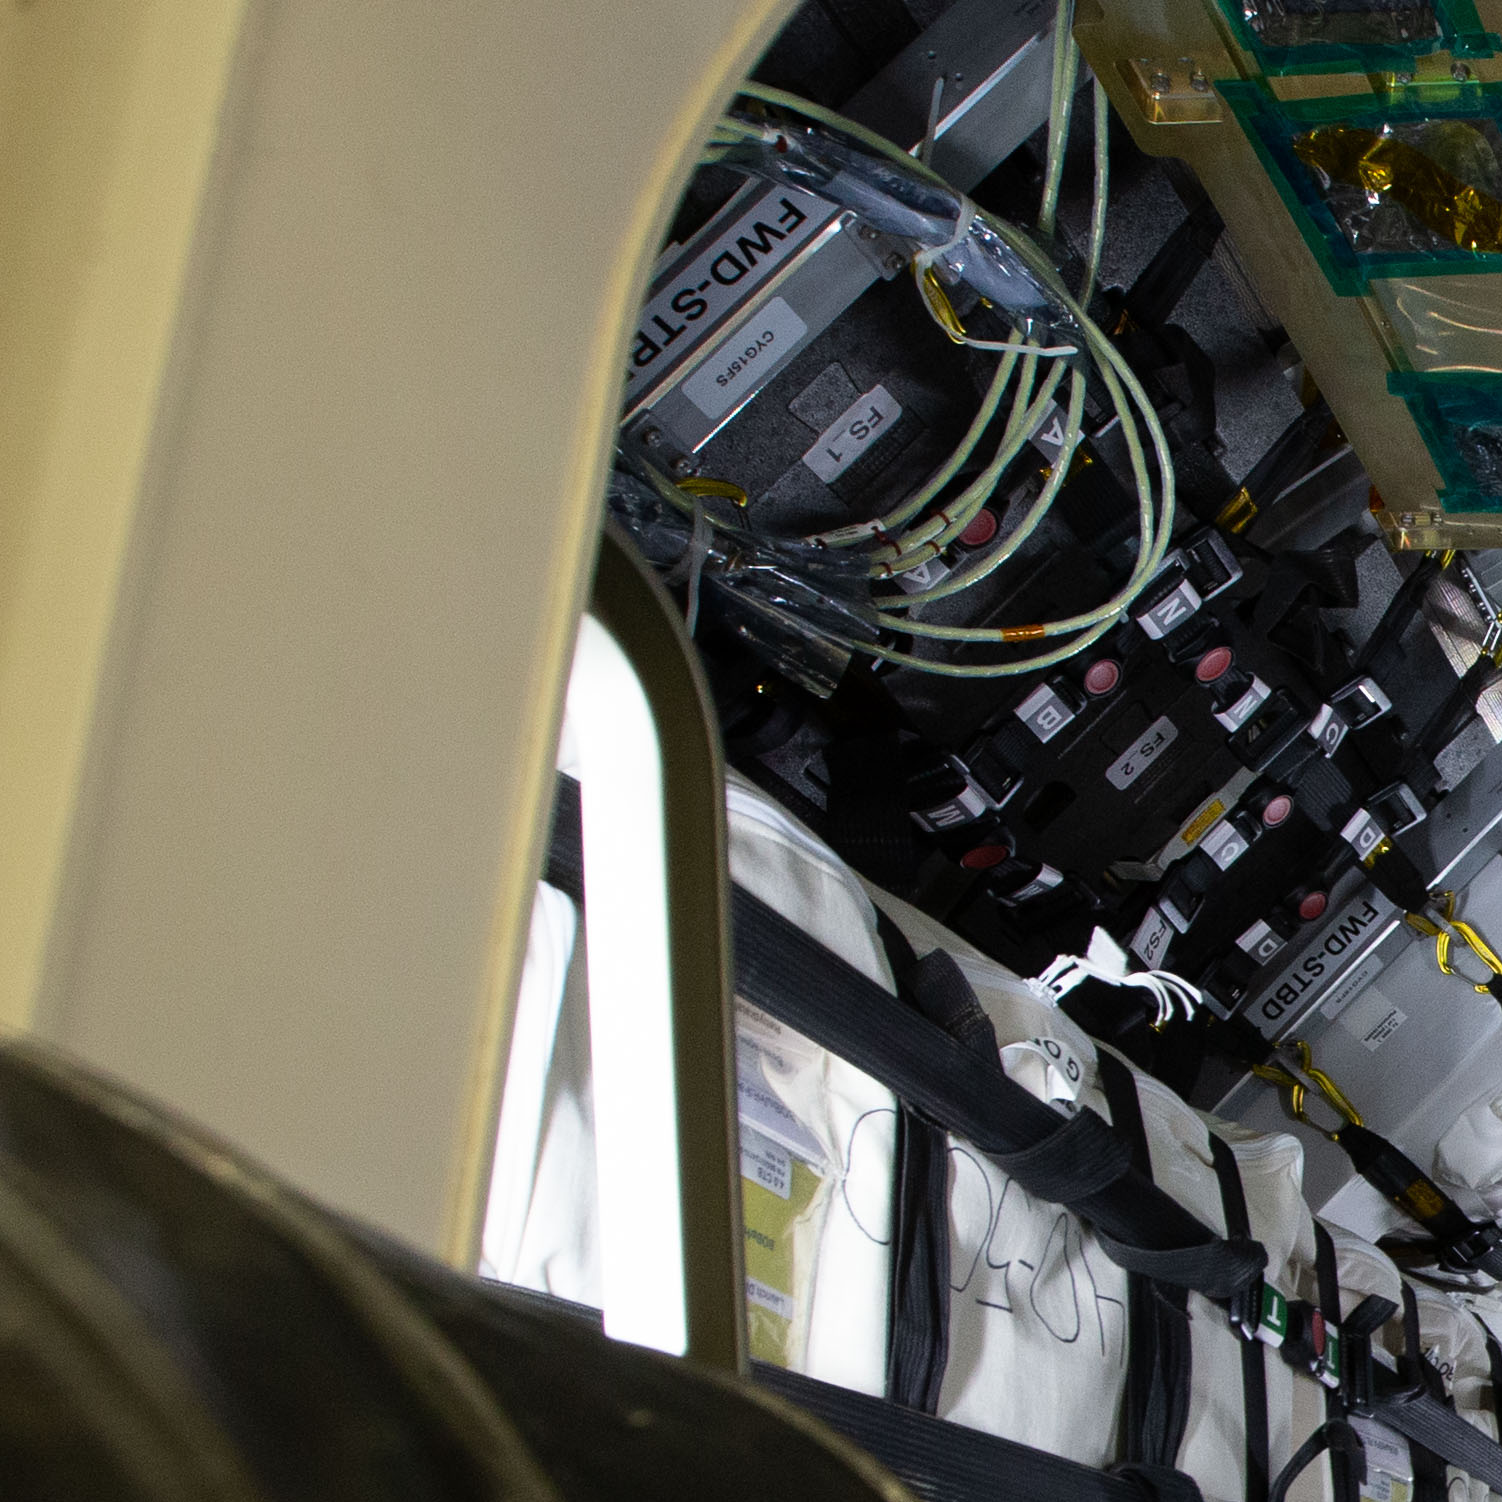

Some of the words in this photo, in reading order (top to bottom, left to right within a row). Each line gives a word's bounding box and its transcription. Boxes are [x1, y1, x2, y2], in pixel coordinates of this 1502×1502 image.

[716, 330, 774, 388] CYG15FS
[827, 404, 885, 463] FS_1
[1036, 705, 1062, 731] B
[1121, 731, 1167, 777] FS_2
[1359, 825, 1377, 847] D
[1222, 842, 1240, 861] C
[1144, 919, 1170, 960] FS2
[1257, 937, 1277, 957] D
[1261, 901, 1379, 1021] FWD-STBD
[1267, 1297, 1284, 1327] T
[1327, 1341, 1338, 1370] T
